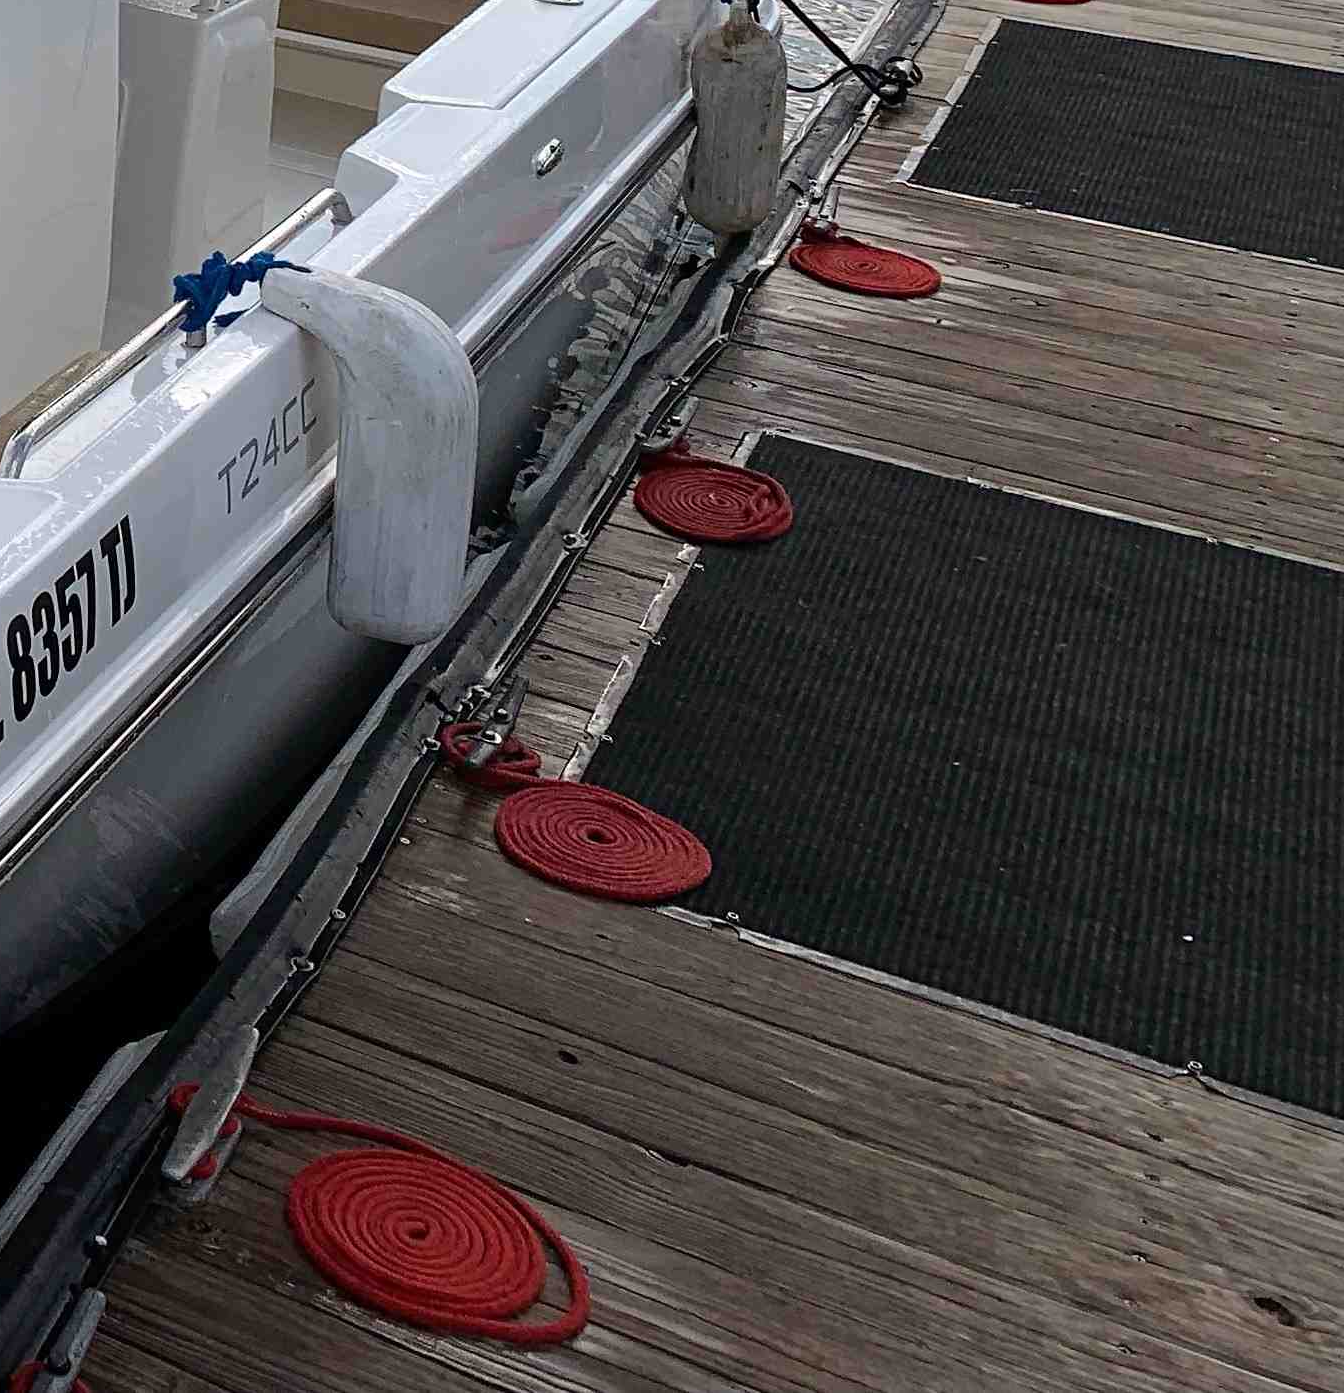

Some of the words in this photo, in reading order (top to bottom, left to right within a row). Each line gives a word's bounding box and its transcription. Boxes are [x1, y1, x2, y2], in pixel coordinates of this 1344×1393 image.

[217, 377, 318, 515] T24CC
[6, 548, 97, 723] 8357
[99, 513, 136, 628] TJ
